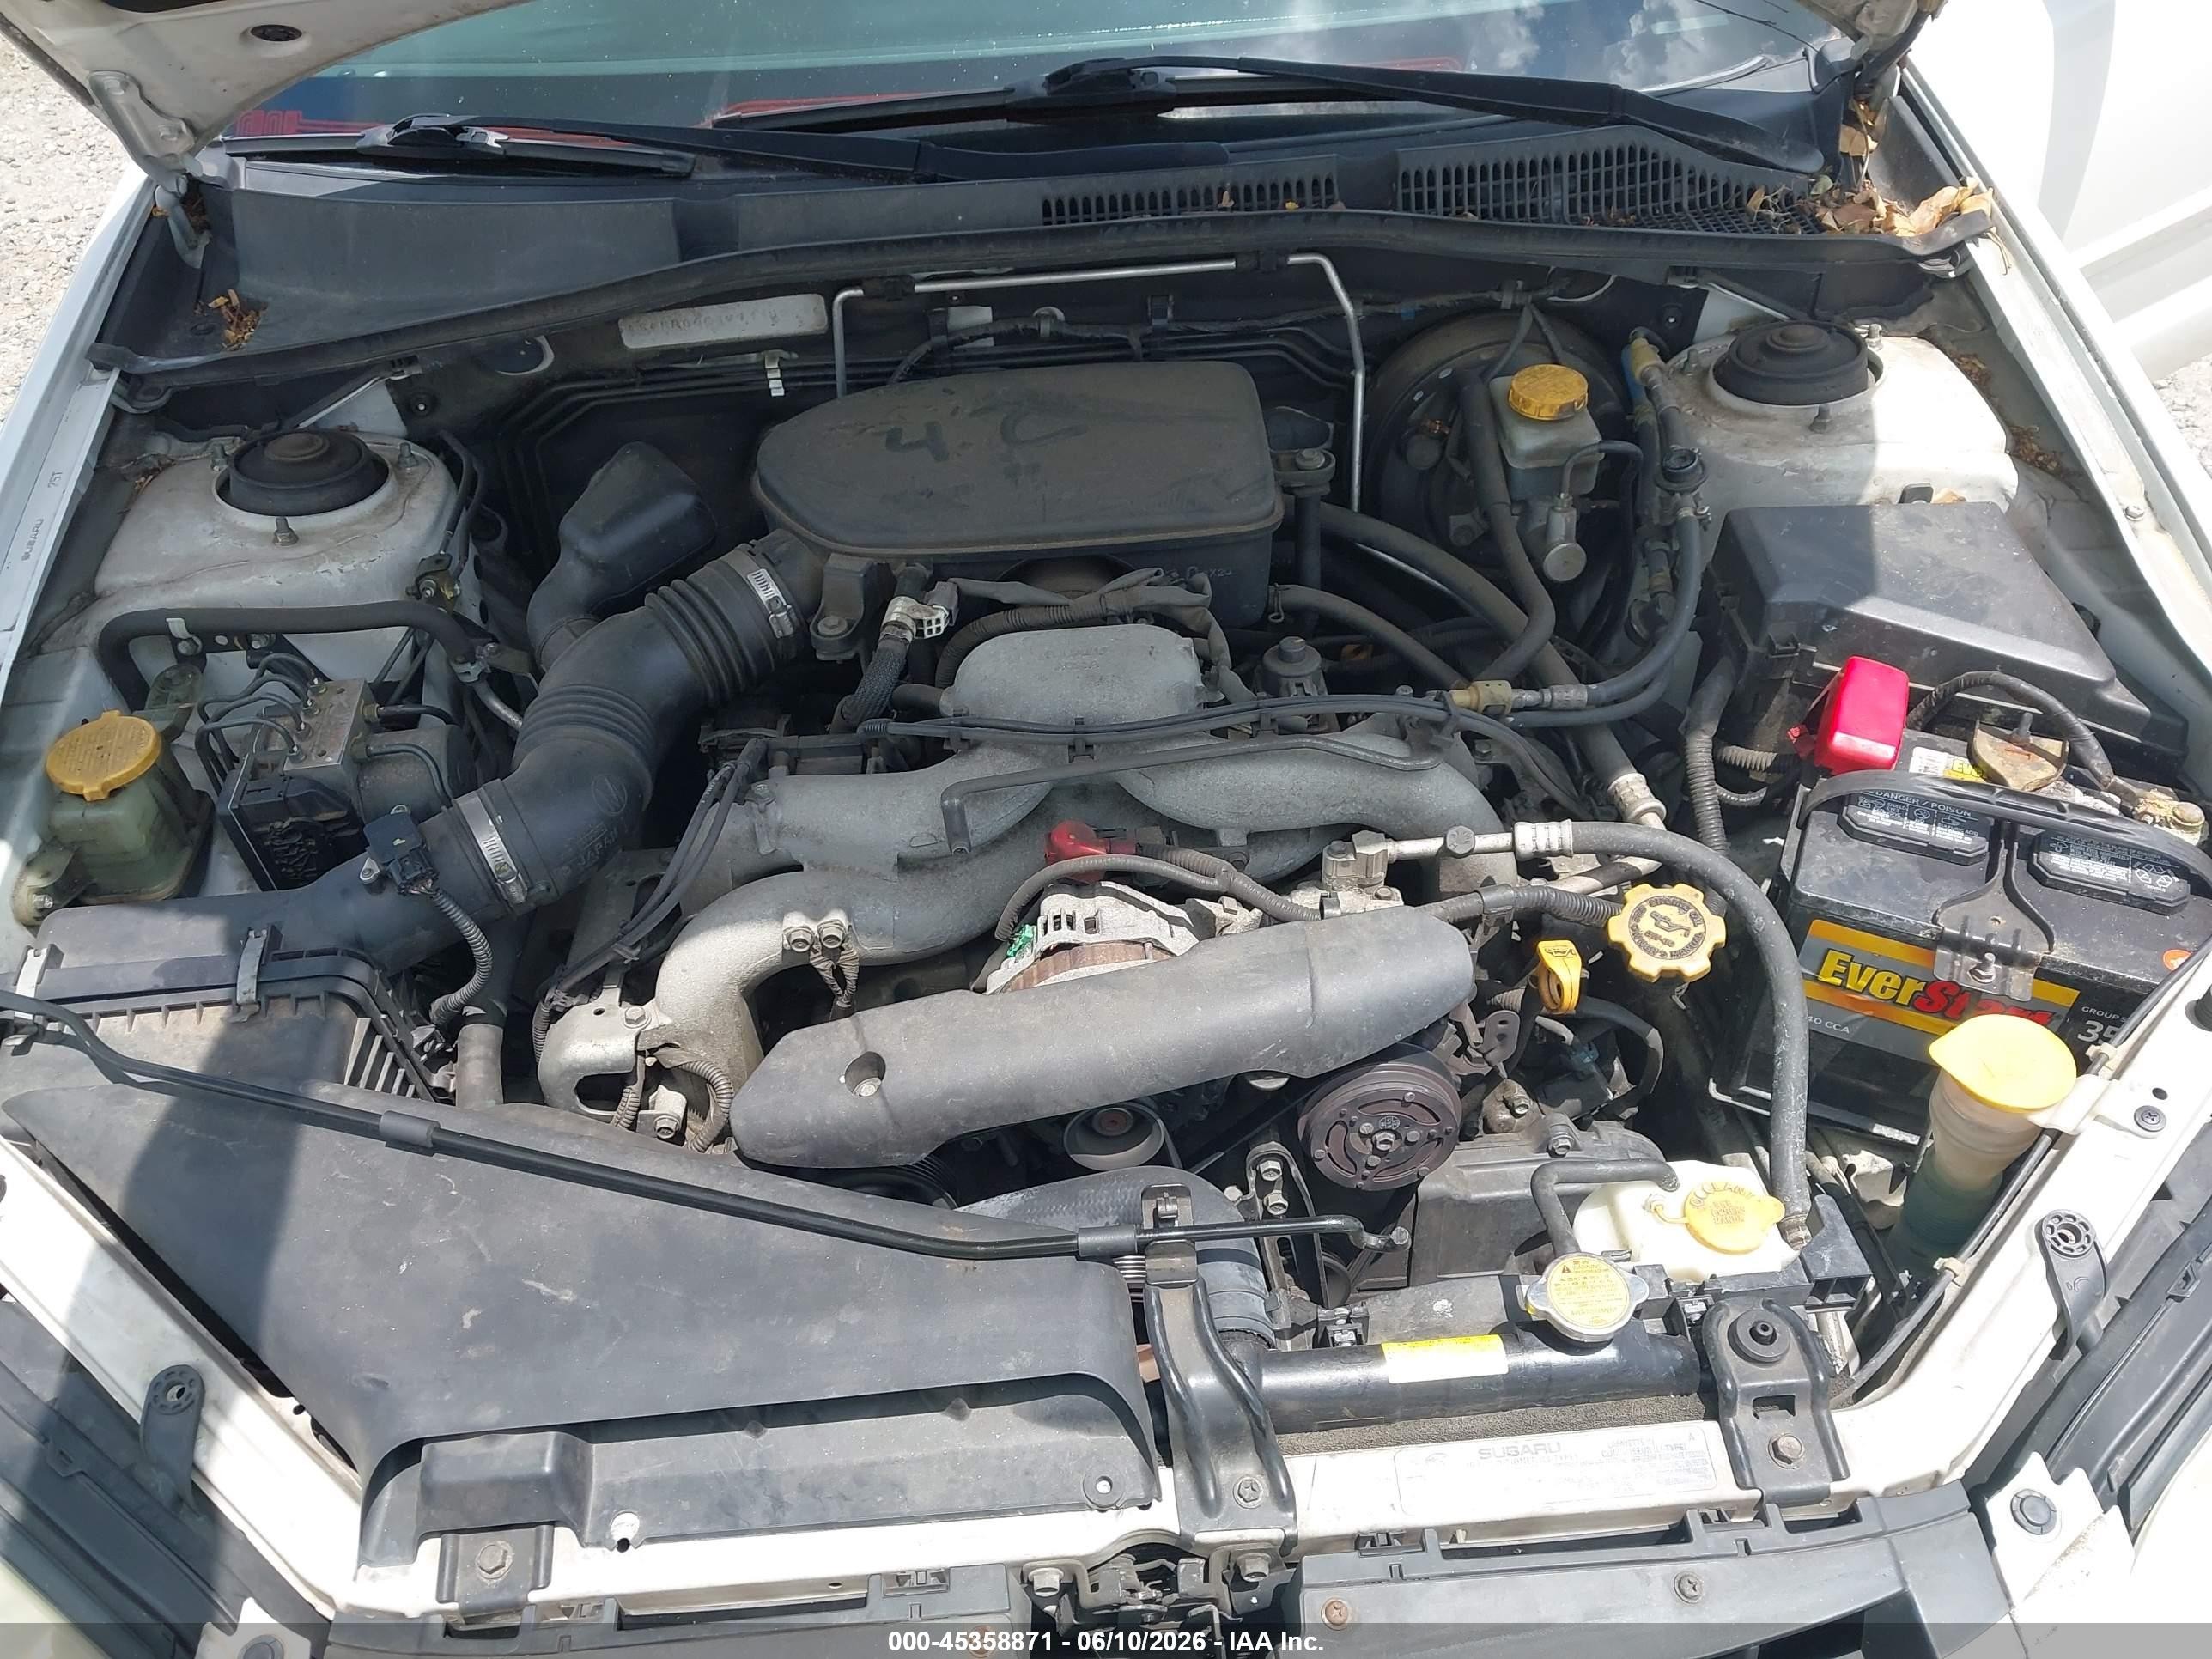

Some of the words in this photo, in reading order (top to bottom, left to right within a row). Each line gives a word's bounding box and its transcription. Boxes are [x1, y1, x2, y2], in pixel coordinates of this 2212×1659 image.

[21, 518, 44, 562] SUBARU
[1875, 790, 1920, 806] DANGER
[1930, 802, 1972, 817] POISON
[1648, 897, 1691, 913] ENGINE
[1689, 910, 1705, 927] OIL
[1669, 933, 1704, 958] MANUAL
[2081, 1006, 2120, 1020] GROUP
[1825, 1021, 1850, 1034] CCA
[1477, 1442, 1562, 1460] SUBARU
